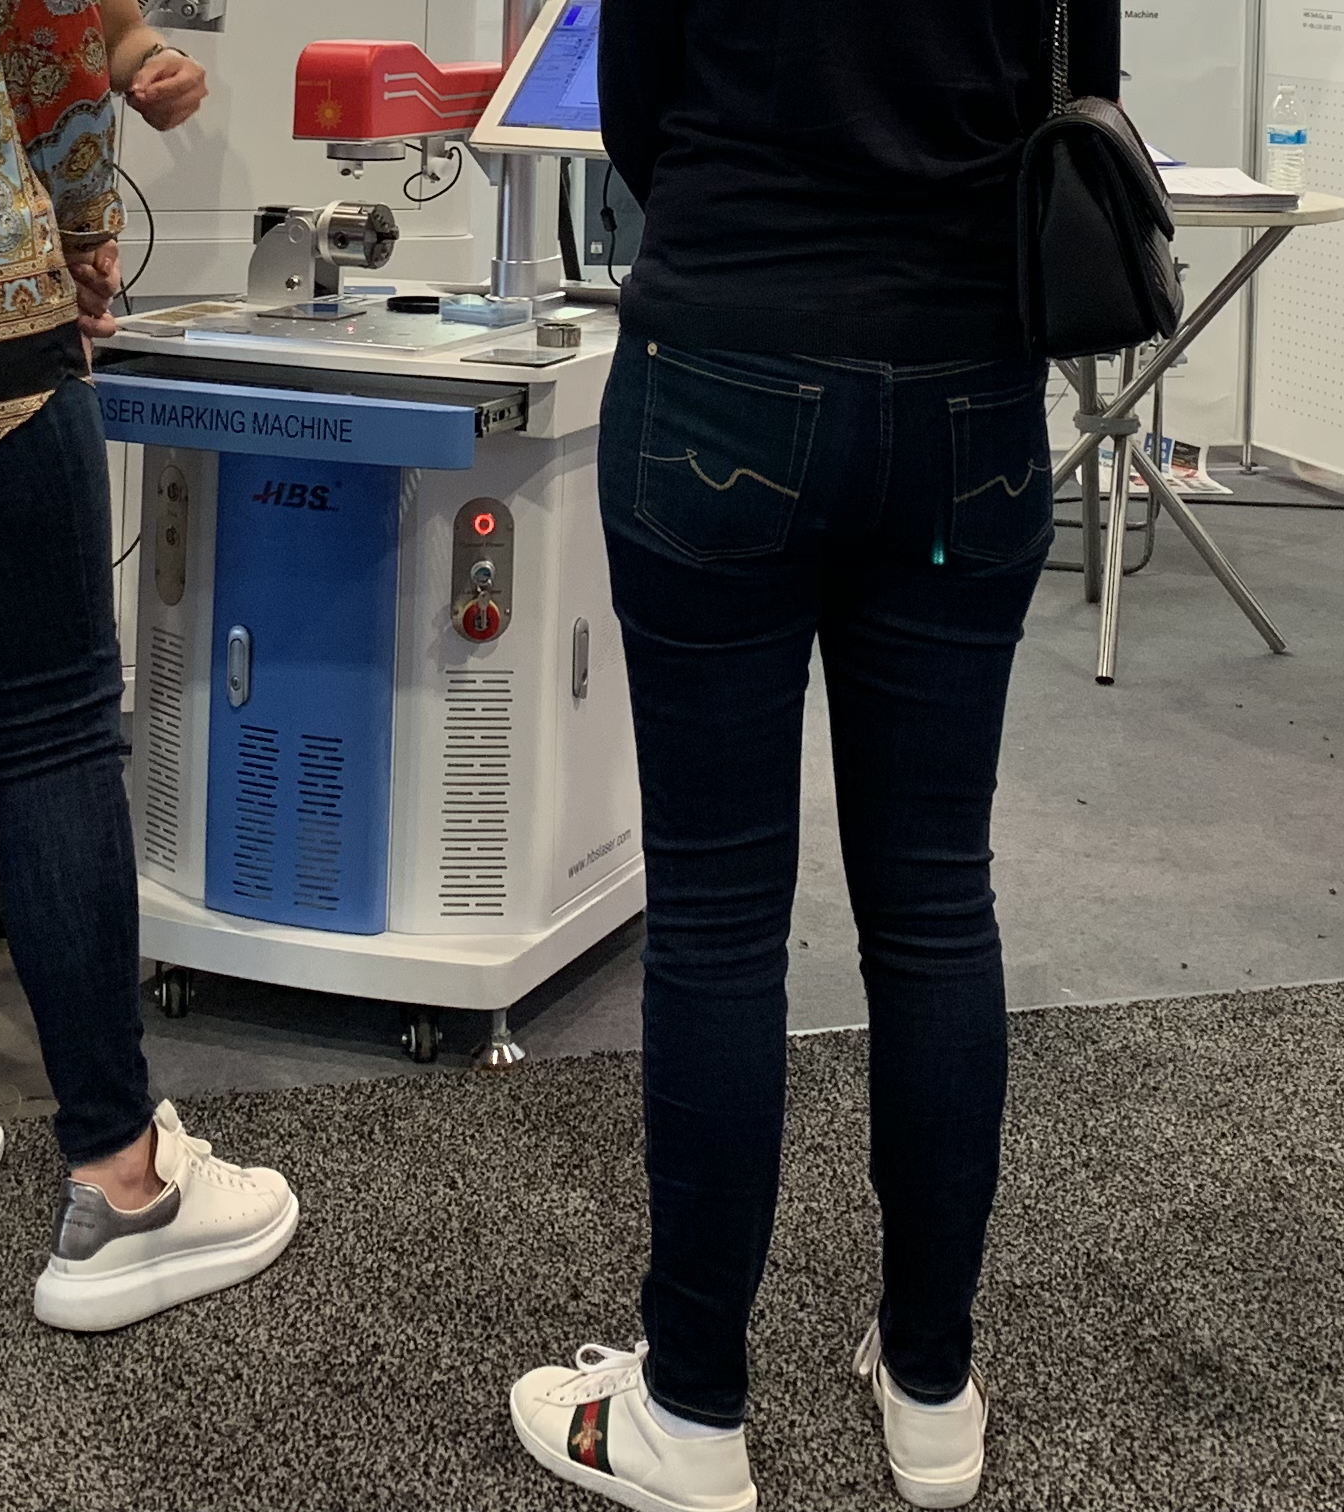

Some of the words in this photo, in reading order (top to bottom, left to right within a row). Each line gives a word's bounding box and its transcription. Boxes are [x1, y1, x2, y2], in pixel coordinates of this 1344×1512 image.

[1124, 10, 1159, 19] Machine
[150, 403, 245, 434] MARKING
[253, 412, 353, 443] MACHINE
[252, 480, 330, 510] HBS
